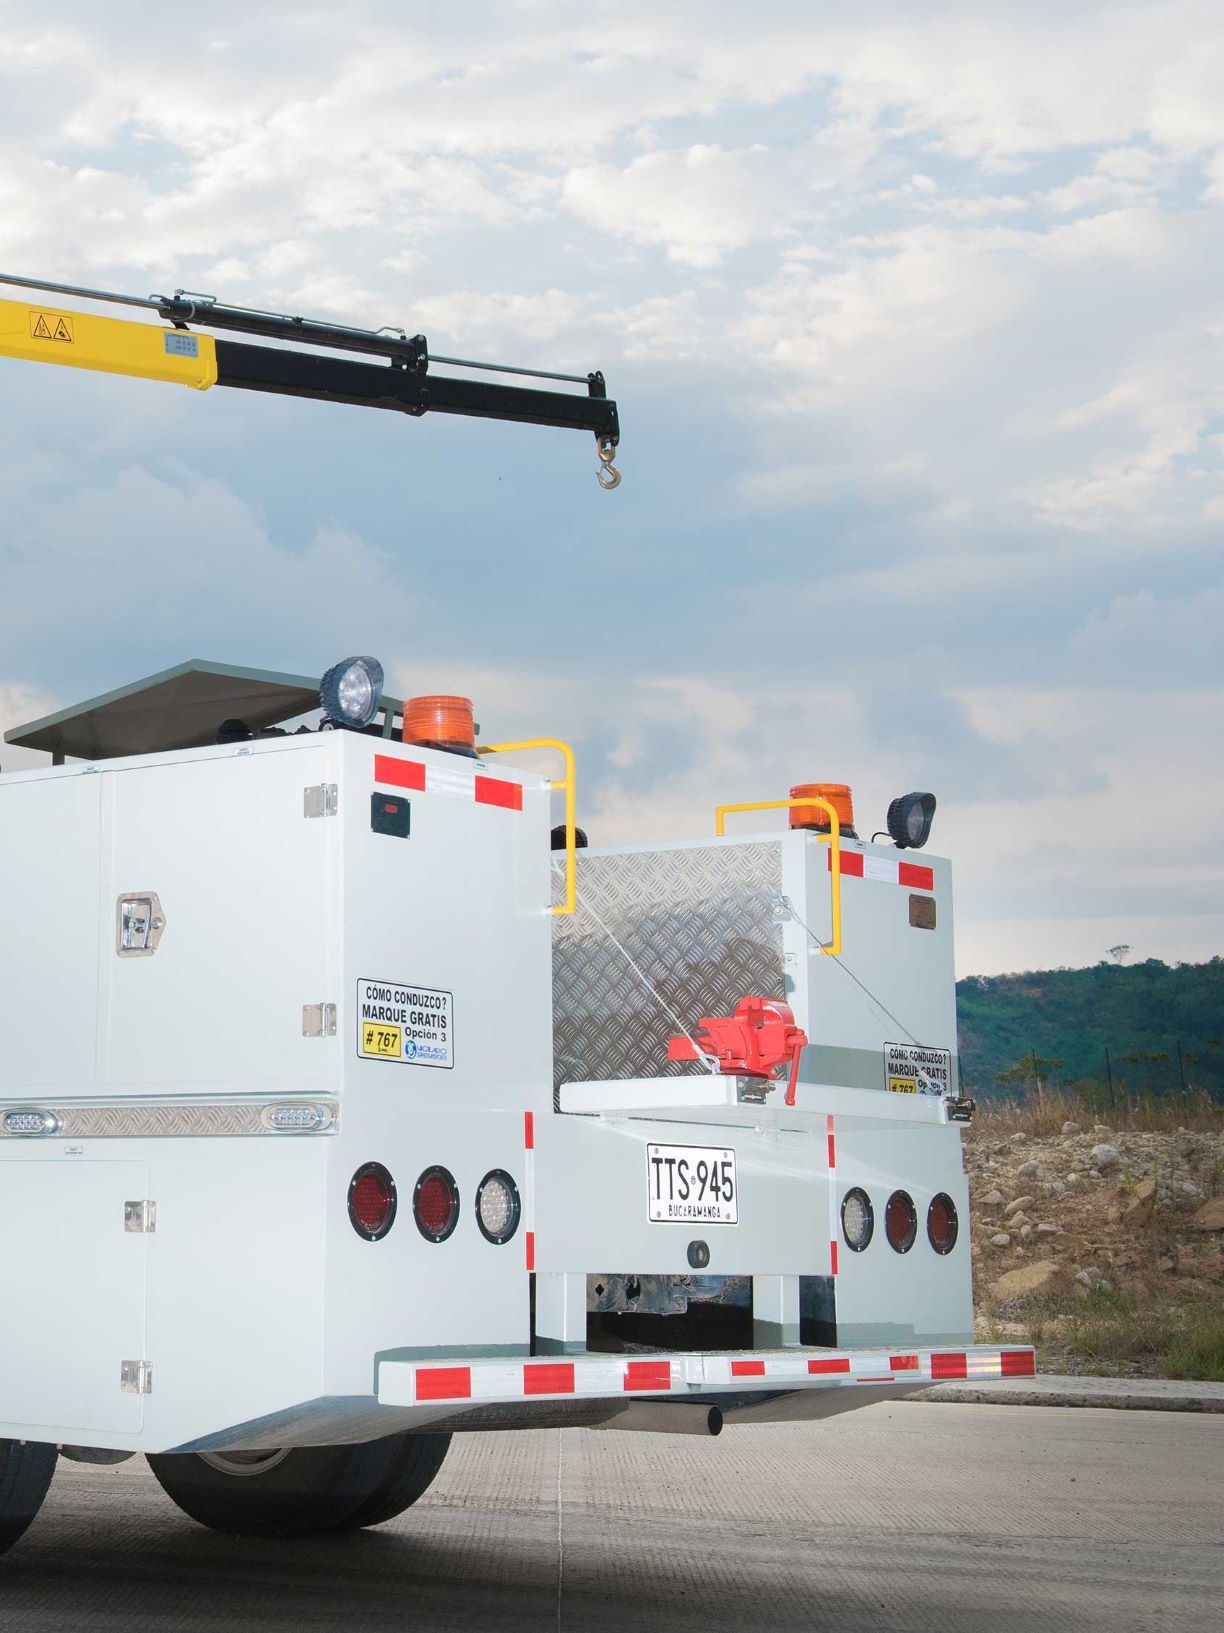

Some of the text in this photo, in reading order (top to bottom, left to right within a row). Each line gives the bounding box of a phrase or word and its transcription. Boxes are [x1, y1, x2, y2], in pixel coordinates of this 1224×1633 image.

[366, 984, 392, 1002] CÓMO
[362, 1003, 447, 1029] MARQUE GRATIS
[366, 1030, 398, 1048] # 767
[404, 1026, 447, 1042] Opción 3
[888, 1062, 919, 1077] MARQUE
[899, 1084, 914, 1093] 767
[942, 1082, 947, 1091] 3
[651, 1157, 734, 1203] TTS 945
[668, 1204, 721, 1218] BUCARAMANGA
